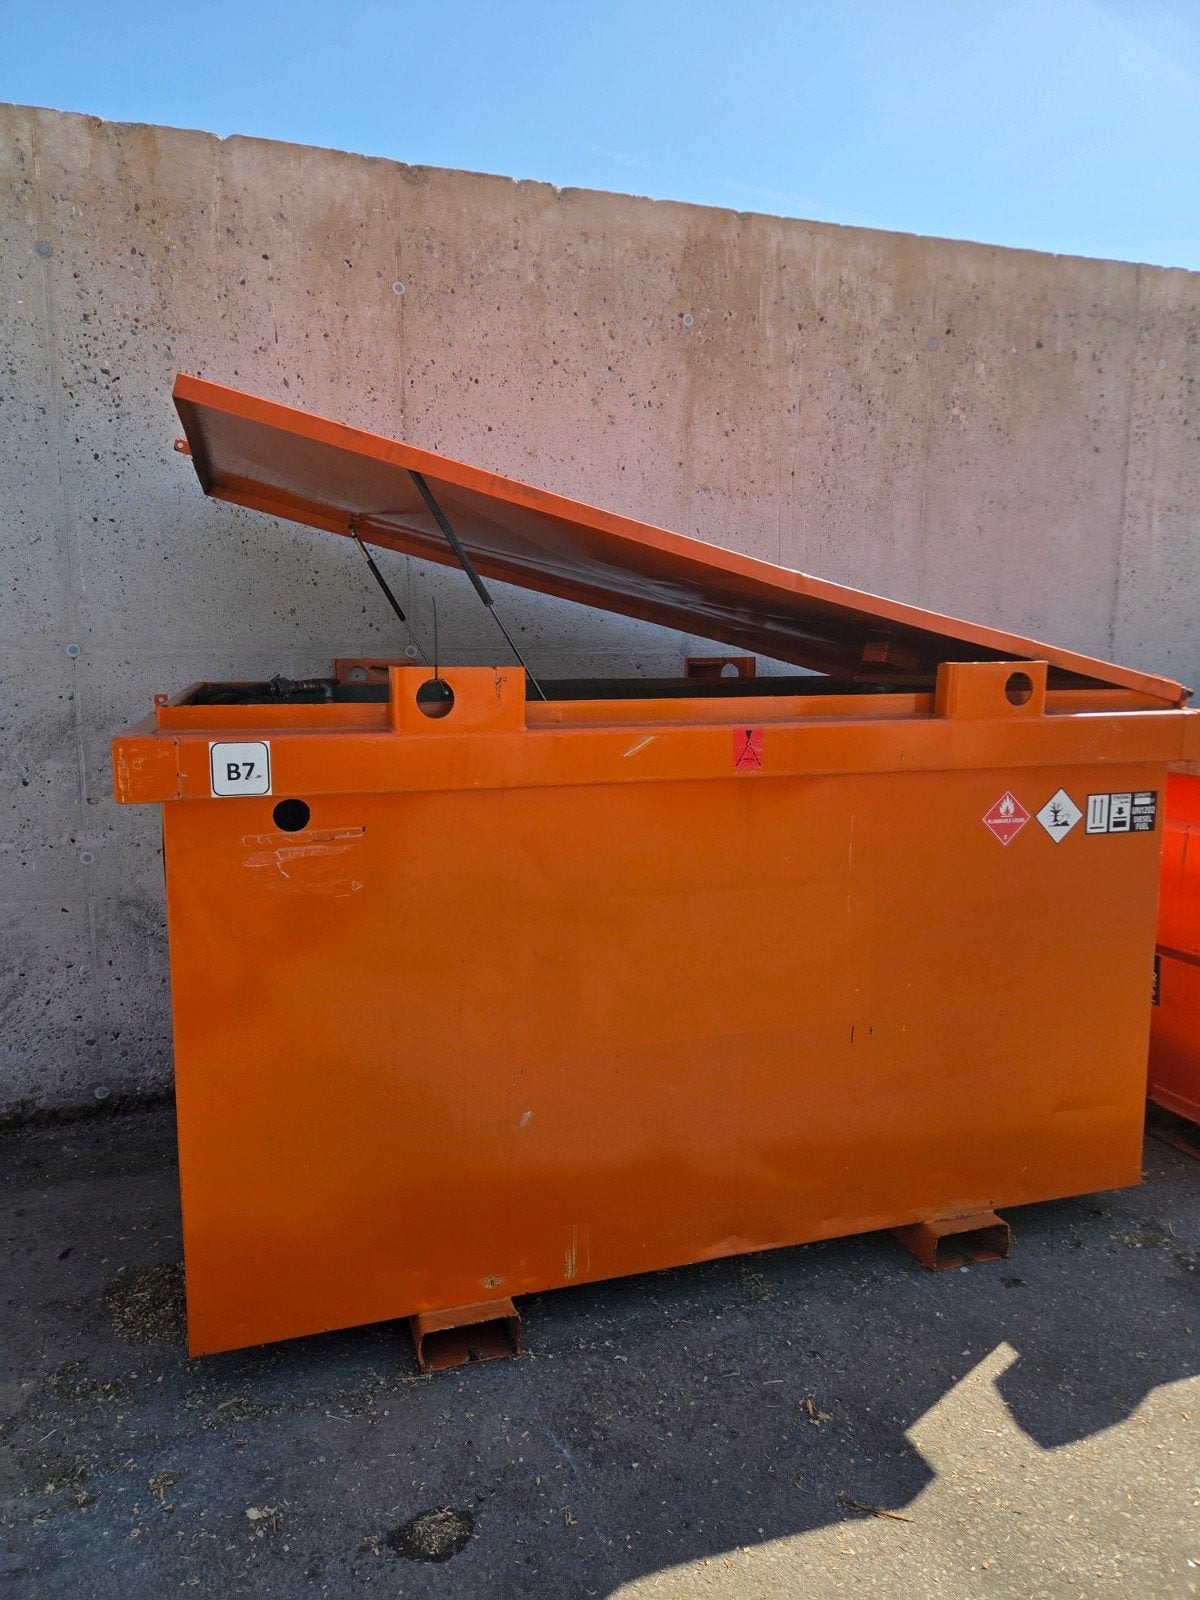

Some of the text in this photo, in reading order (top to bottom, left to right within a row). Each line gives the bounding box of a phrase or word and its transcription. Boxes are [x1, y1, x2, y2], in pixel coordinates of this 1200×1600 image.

[227, 762, 255, 781] B7
[1132, 806, 1155, 815] UN1202
[1133, 815, 1152, 823] DIESEL
